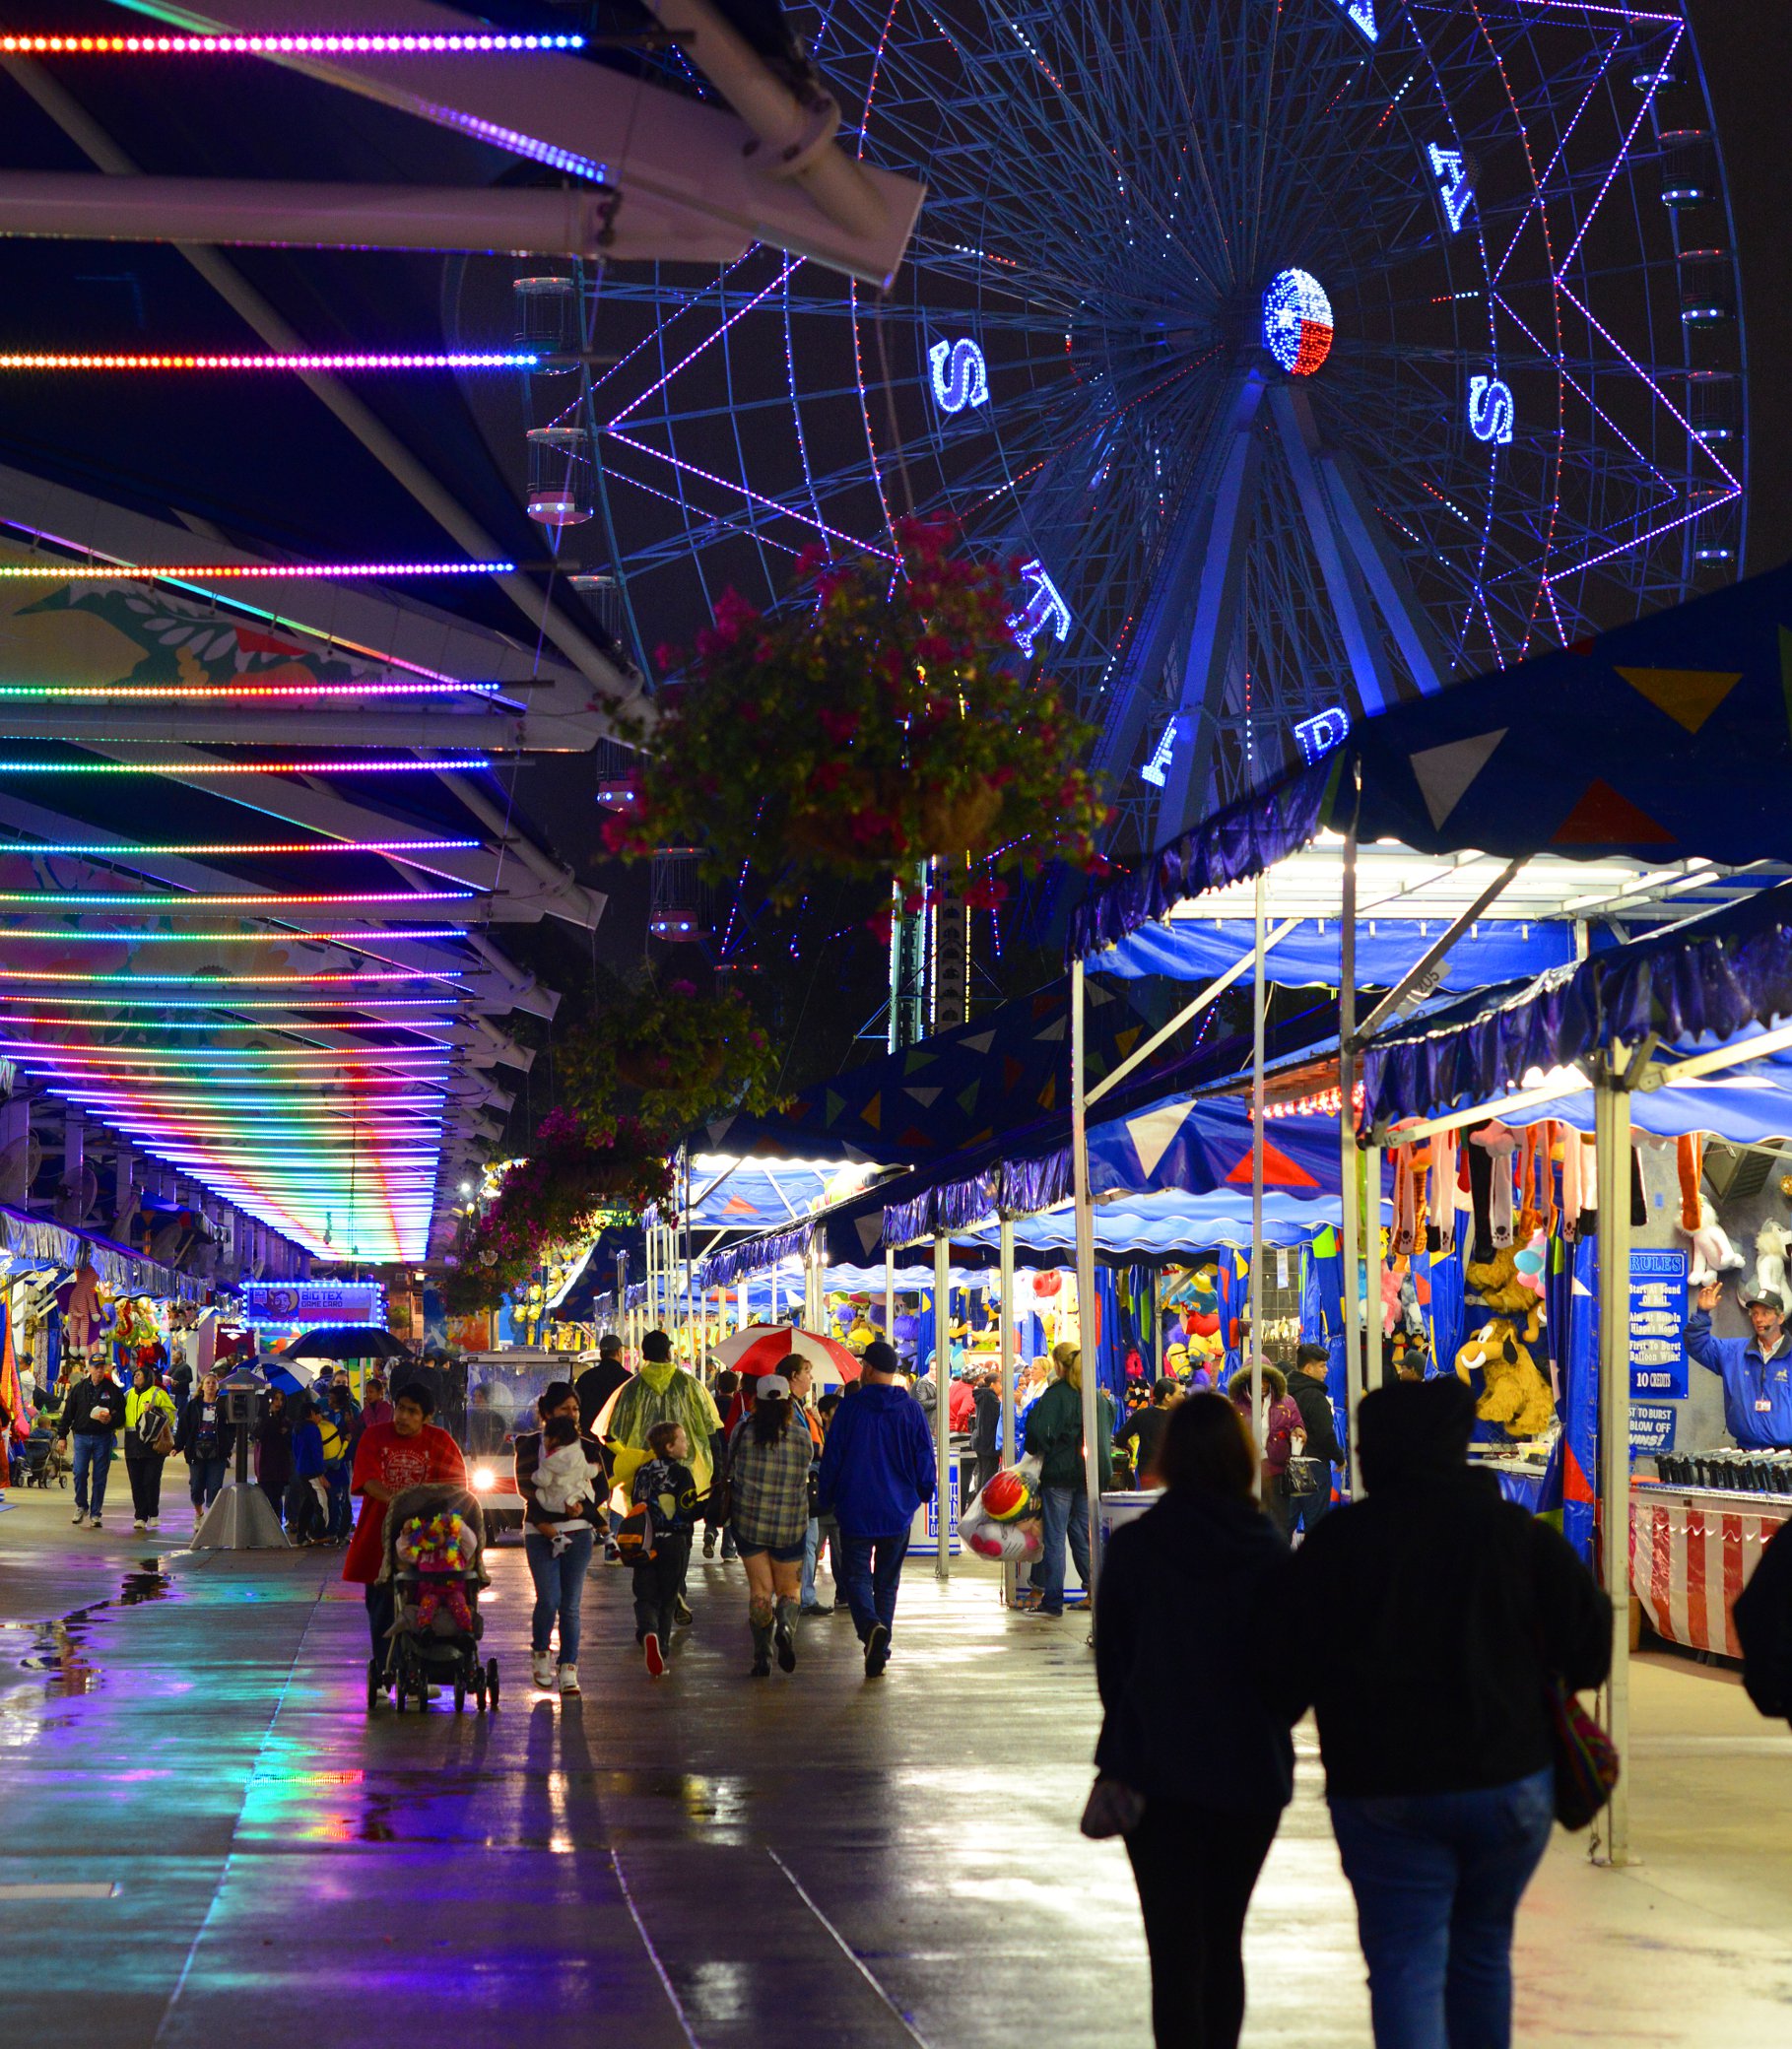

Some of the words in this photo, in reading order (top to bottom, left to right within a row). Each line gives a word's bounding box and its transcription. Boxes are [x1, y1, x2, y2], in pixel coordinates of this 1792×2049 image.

[1629, 1256, 1682, 1272] RULES
[1628, 1284, 1647, 1294] Start
[321, 1291, 343, 1300] TEX
[1628, 1311, 1644, 1323] Aim
[1628, 1340, 1647, 1351] First
[1649, 1340, 1659, 1351] To
[1661, 1340, 1682, 1351] Burst
[1629, 1351, 1657, 1361] Balloon
[1636, 1372, 1649, 1387] 10
[1650, 1372, 1672, 1387] CREDITS
[1648, 1409, 1673, 1421] BURST
[1629, 1421, 1654, 1432] BLOW
[1655, 1422, 1672, 1433] OFF
